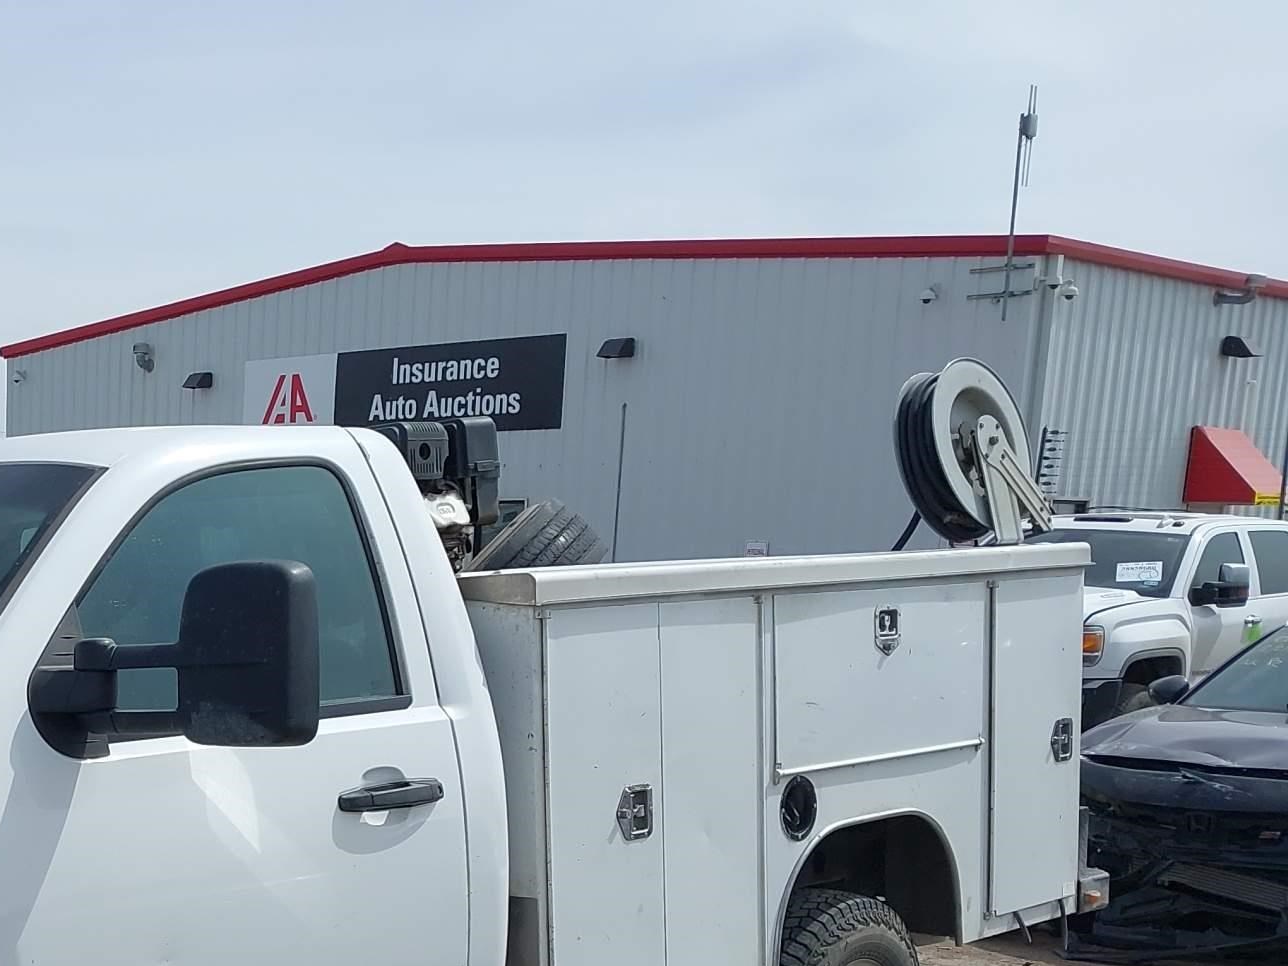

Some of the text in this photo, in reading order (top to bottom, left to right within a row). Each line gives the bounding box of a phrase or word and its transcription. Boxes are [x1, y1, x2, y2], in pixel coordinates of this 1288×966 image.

[392, 356, 500, 385] Insurance
[368, 387, 521, 422] Auto Auctions
